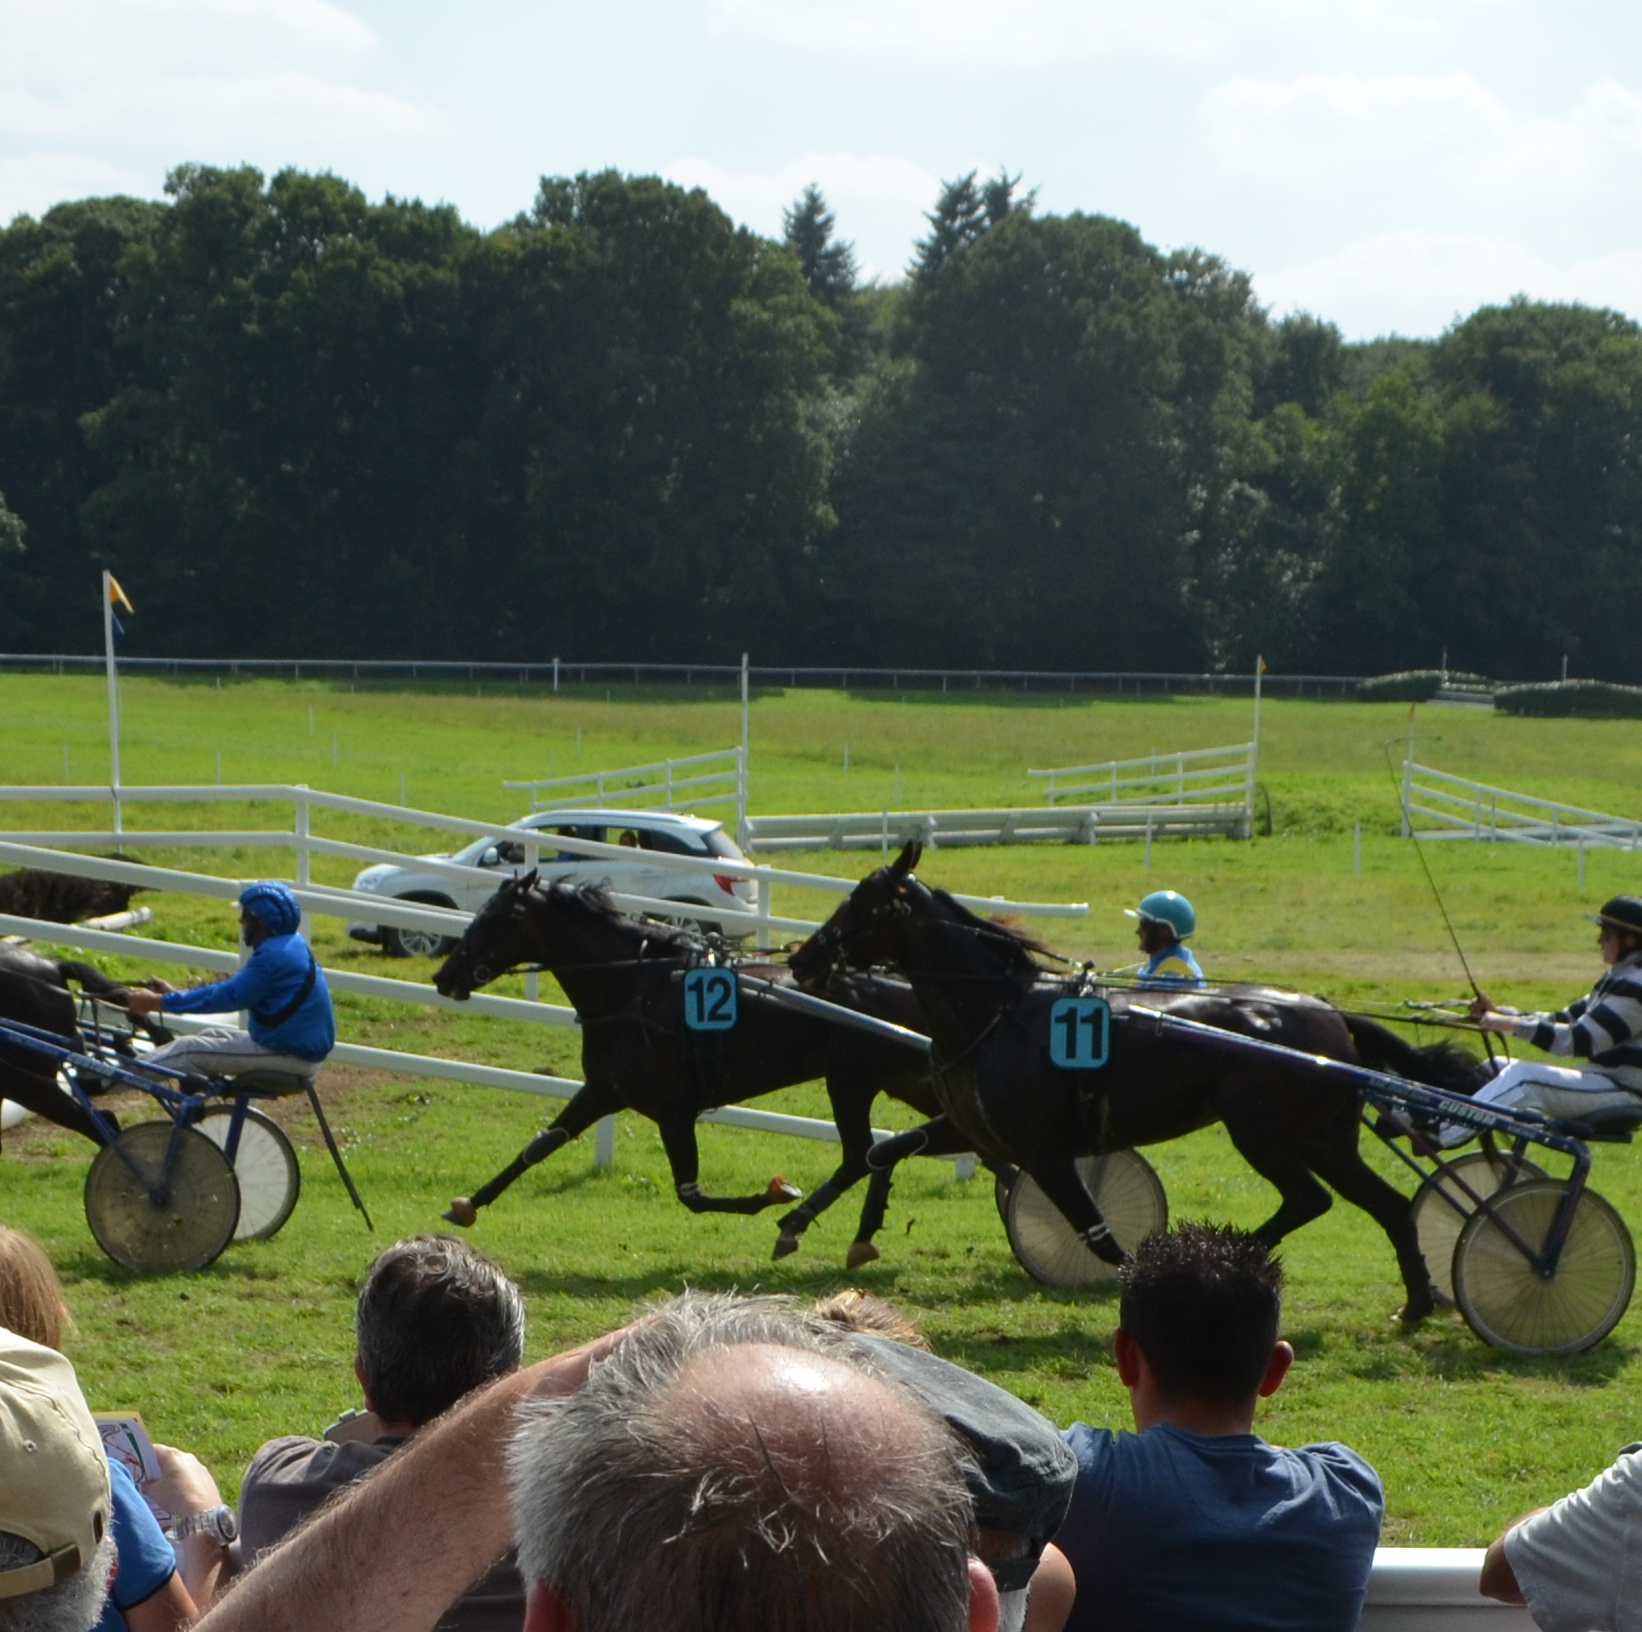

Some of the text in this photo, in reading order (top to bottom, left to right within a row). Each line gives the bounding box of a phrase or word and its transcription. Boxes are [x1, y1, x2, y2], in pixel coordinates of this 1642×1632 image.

[687, 976, 732, 1022] 12
[1055, 1007, 1103, 1060] 11
[1437, 1100, 1498, 1126] CUSTOM
